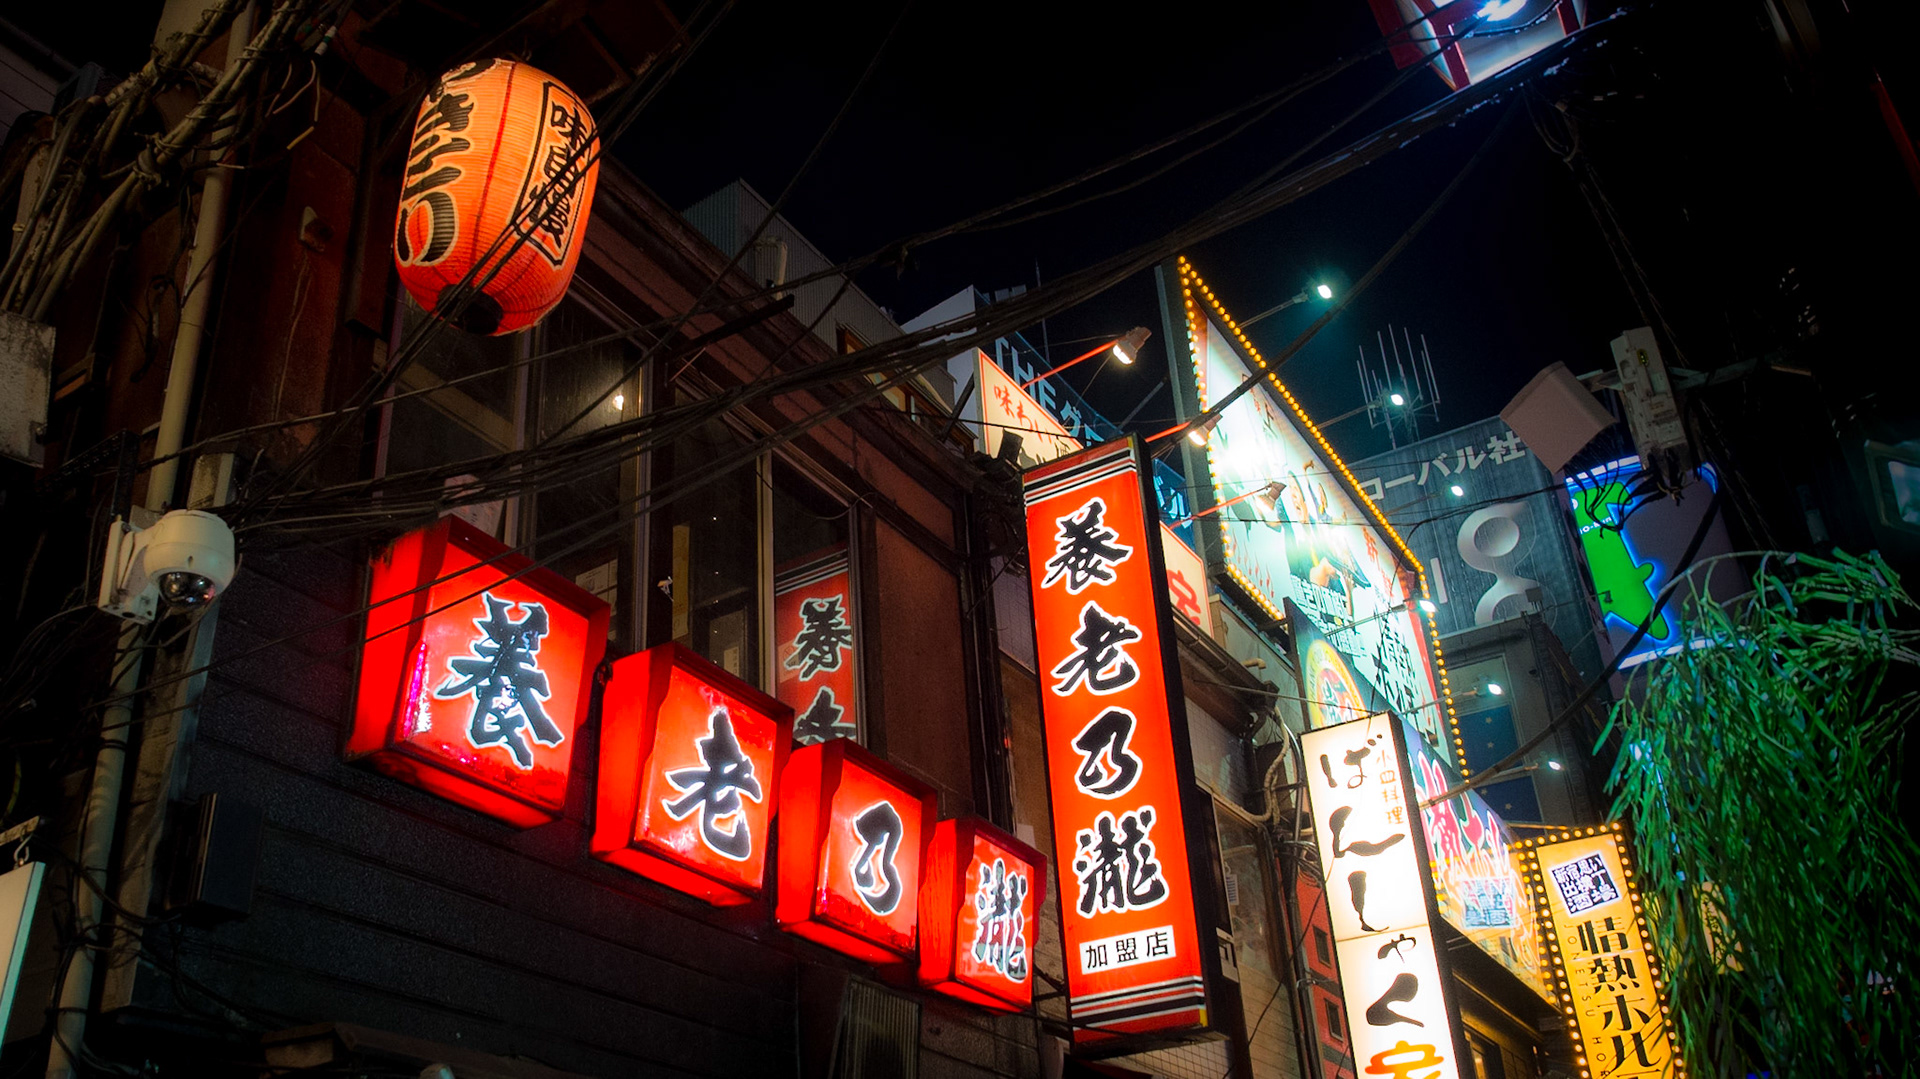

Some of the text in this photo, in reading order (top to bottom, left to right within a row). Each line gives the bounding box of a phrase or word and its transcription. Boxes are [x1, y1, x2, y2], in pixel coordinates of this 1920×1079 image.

[1376, 750, 1404, 825] 小皿料理
[1086, 931, 1169, 969] 加盟店
[1564, 924, 1597, 1017] JONETSU
[1577, 916, 1662, 1079] 情熱ホル
